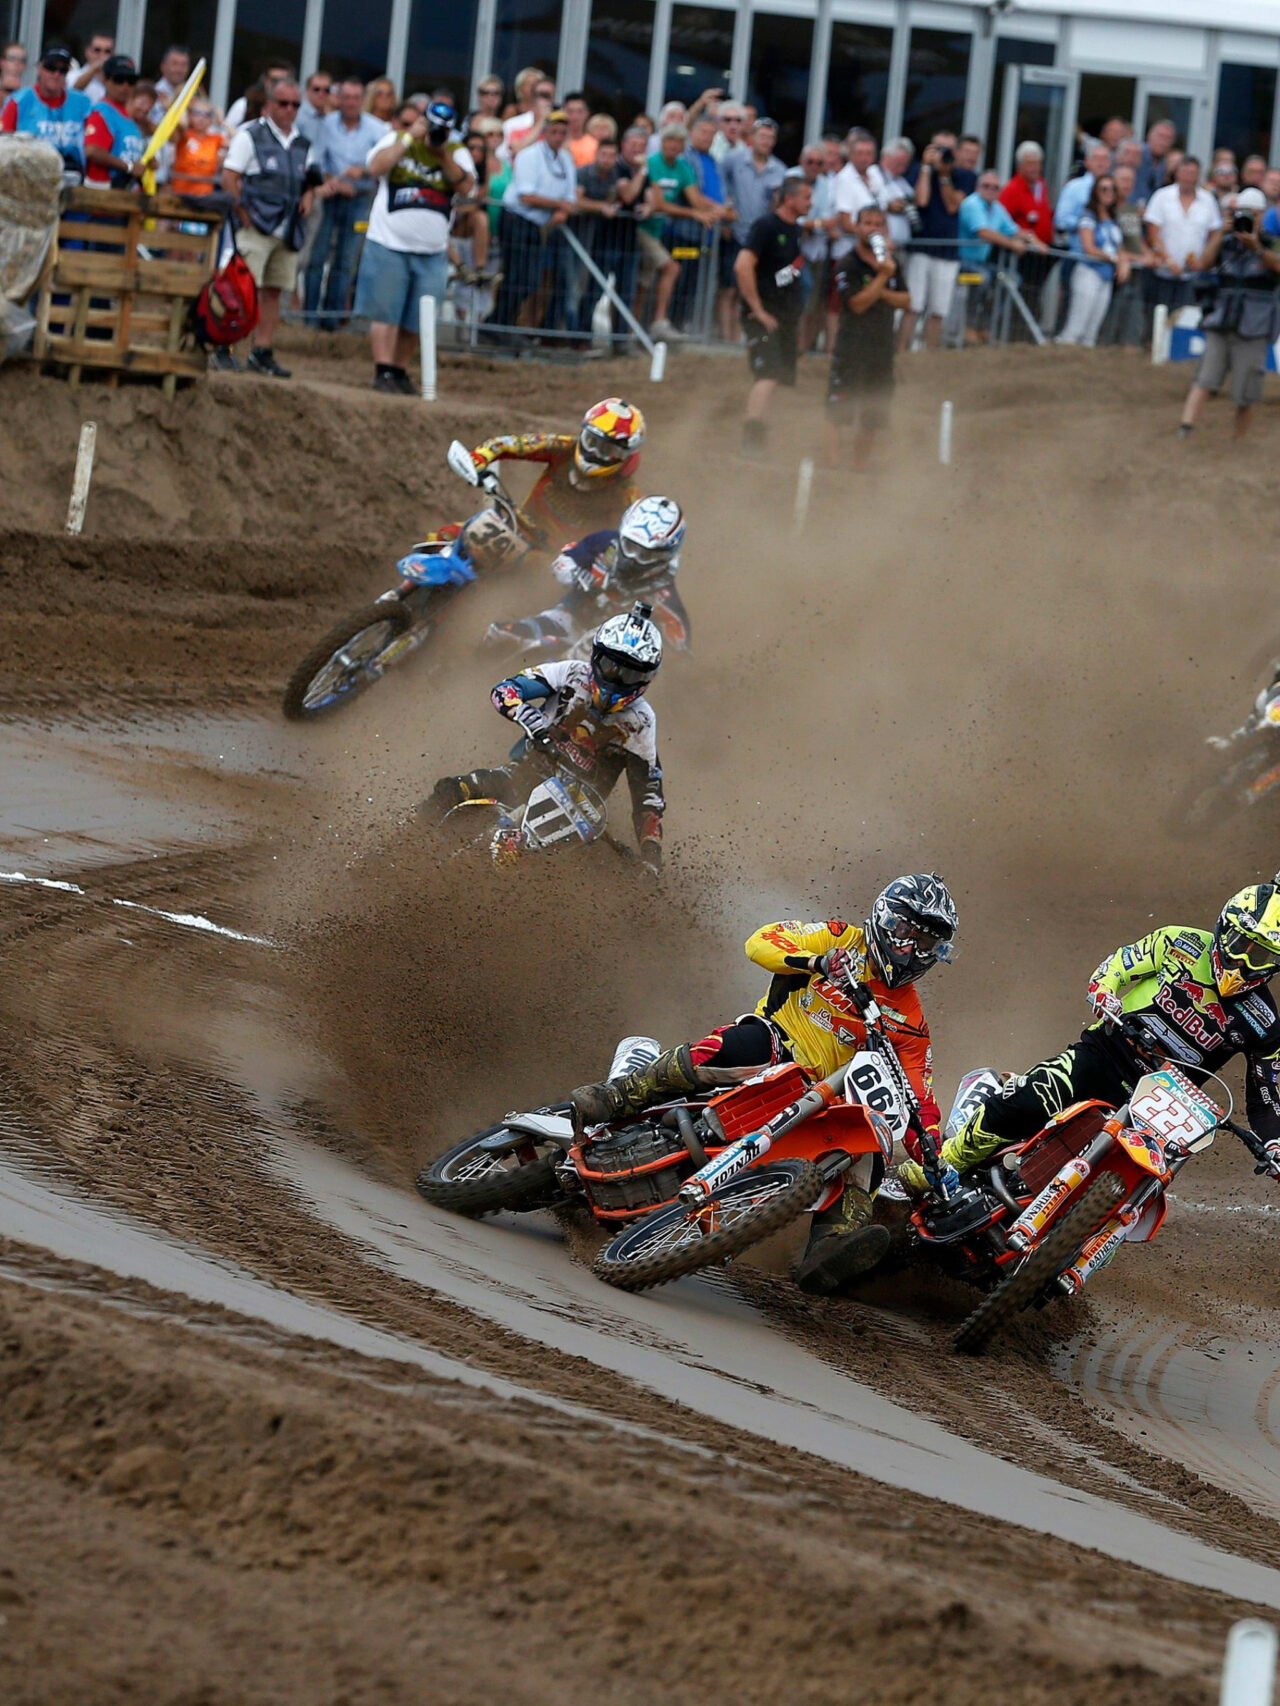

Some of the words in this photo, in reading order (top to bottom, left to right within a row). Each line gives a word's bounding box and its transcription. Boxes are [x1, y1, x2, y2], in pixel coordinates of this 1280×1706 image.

[1155, 984, 1194, 1026] Red
[1182, 1012, 1225, 1050] Bull
[1131, 1085, 1206, 1147] 222
[1169, 1086, 1214, 1130] MOTOREX
[1025, 1193, 1053, 1222] ATHENA
[1094, 1235, 1120, 1264] ATHENA
